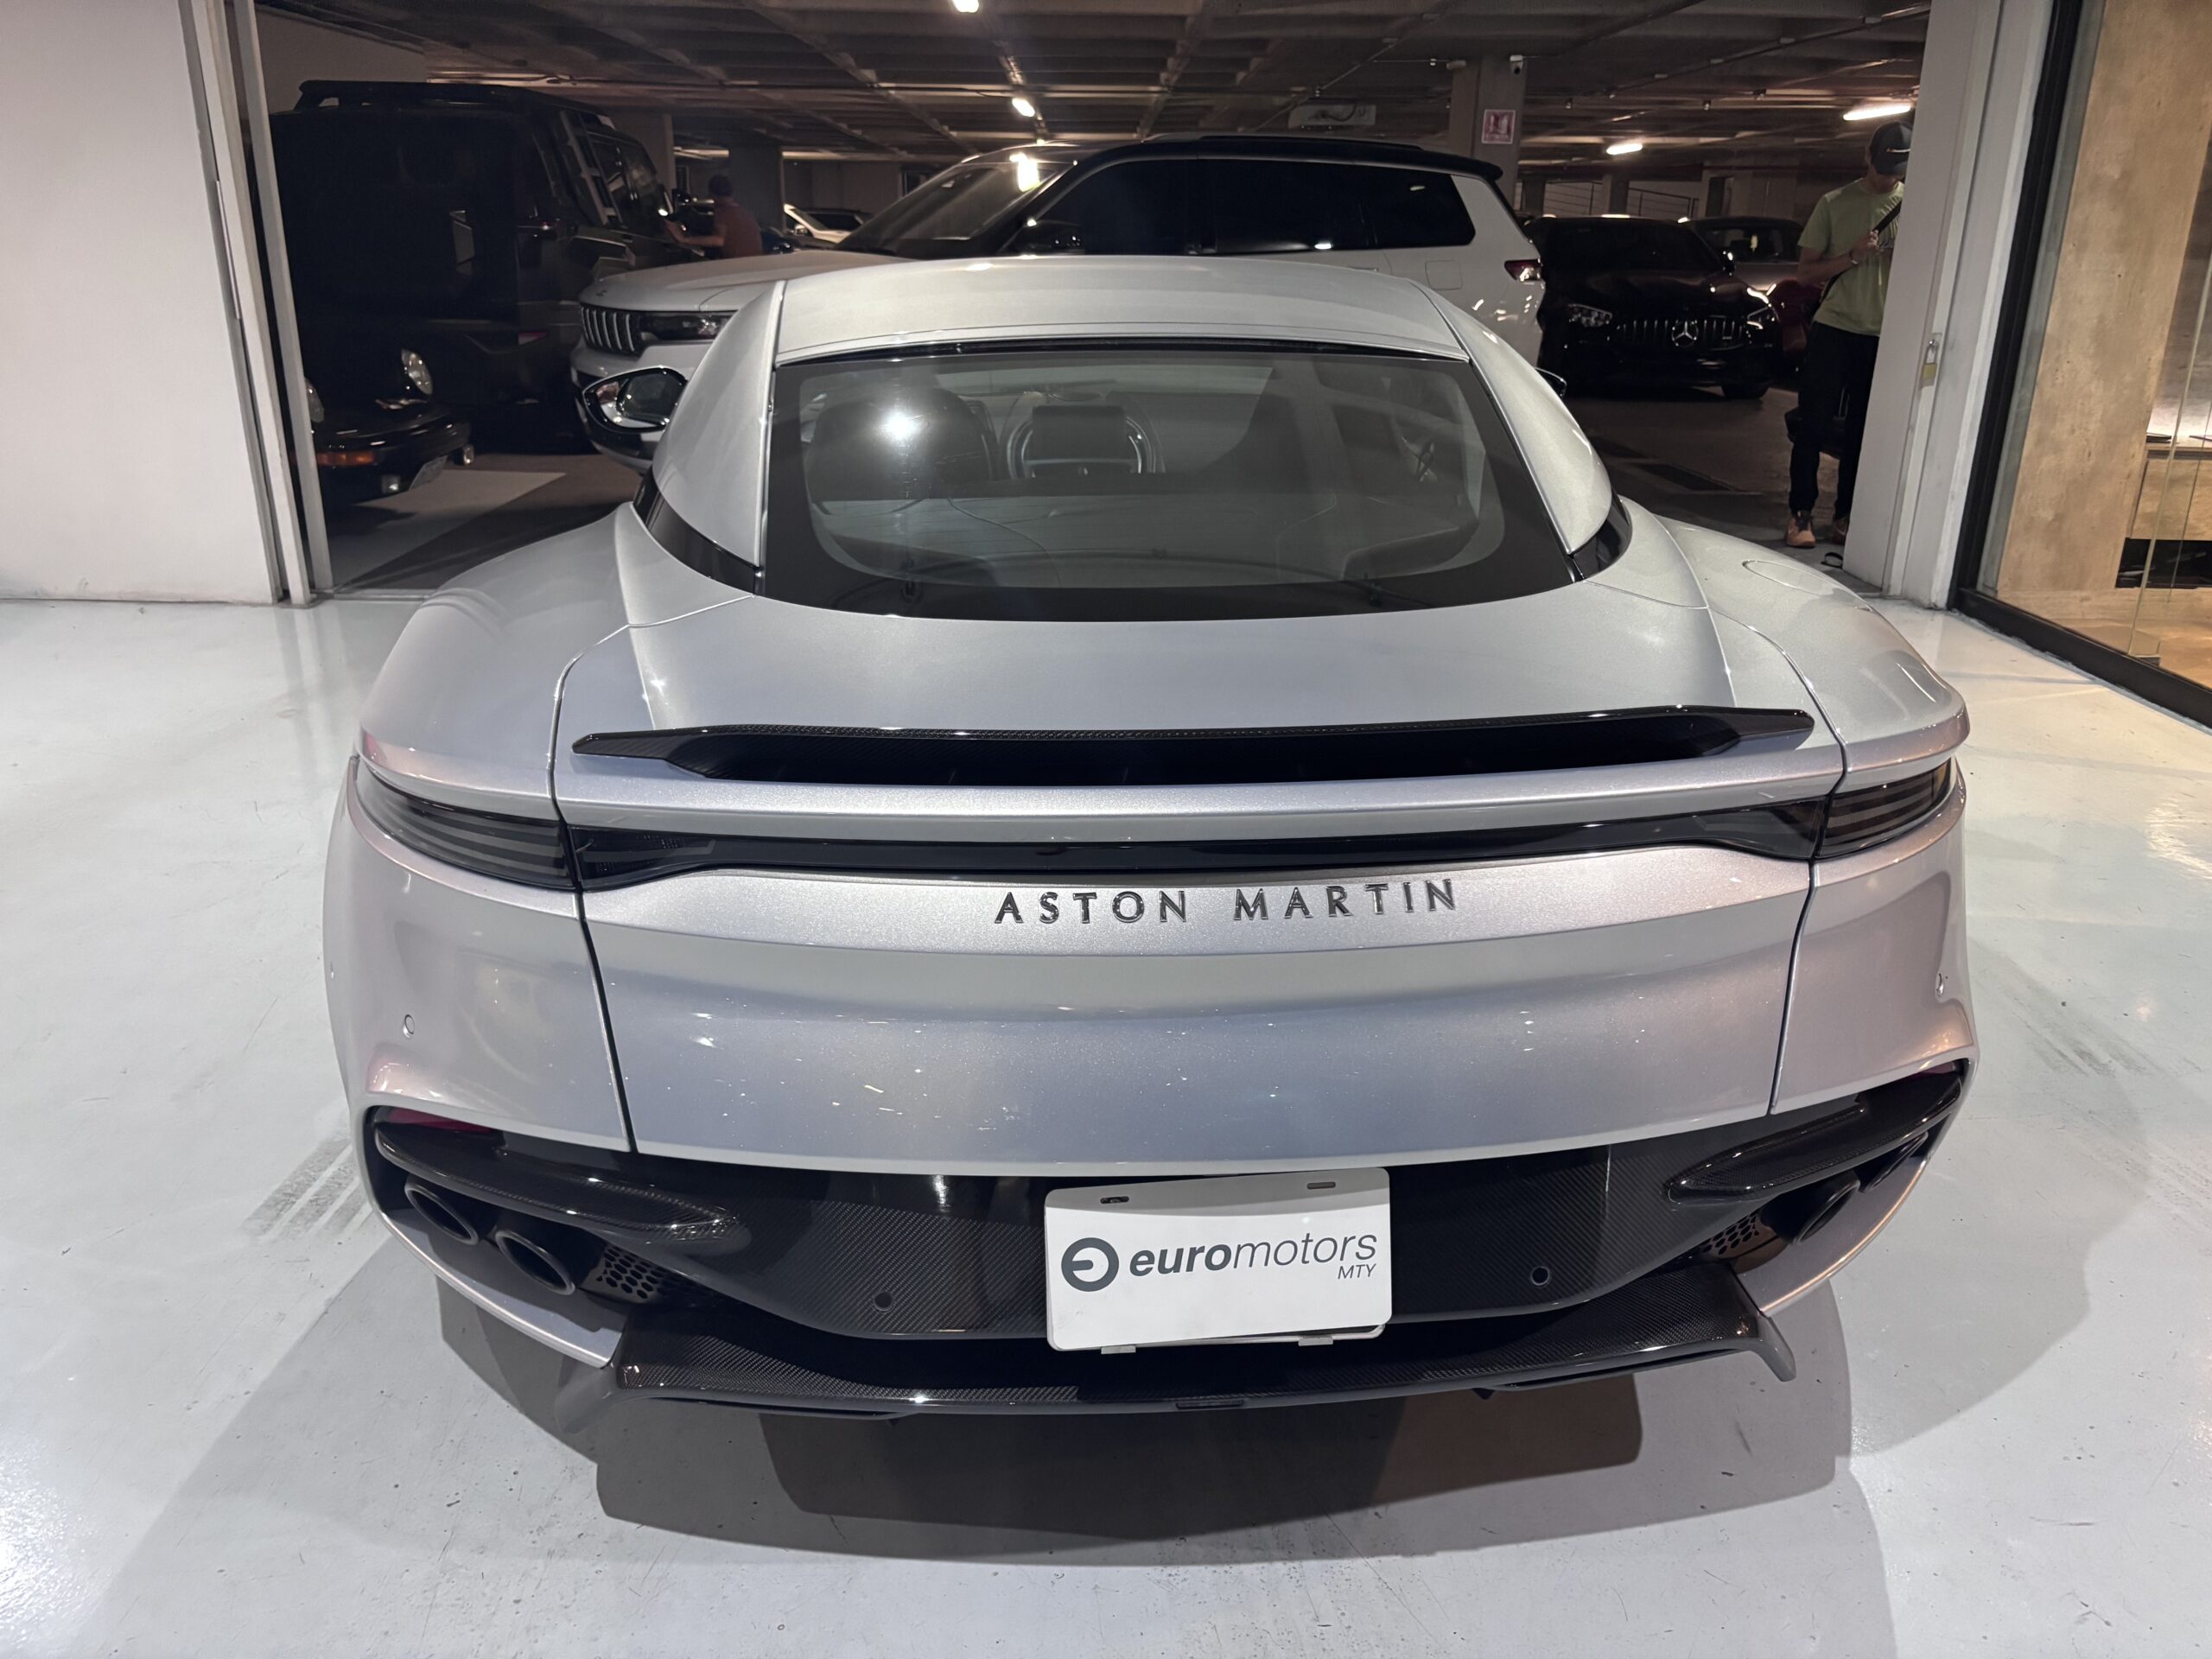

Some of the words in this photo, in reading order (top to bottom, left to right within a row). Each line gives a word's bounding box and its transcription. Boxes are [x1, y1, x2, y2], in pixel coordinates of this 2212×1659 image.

[994, 890, 1187, 925] ASTON
[1232, 879, 1458, 921] MARTIN
[1128, 1232, 1377, 1277] euromotors
[1337, 1263, 1376, 1280] MTY
